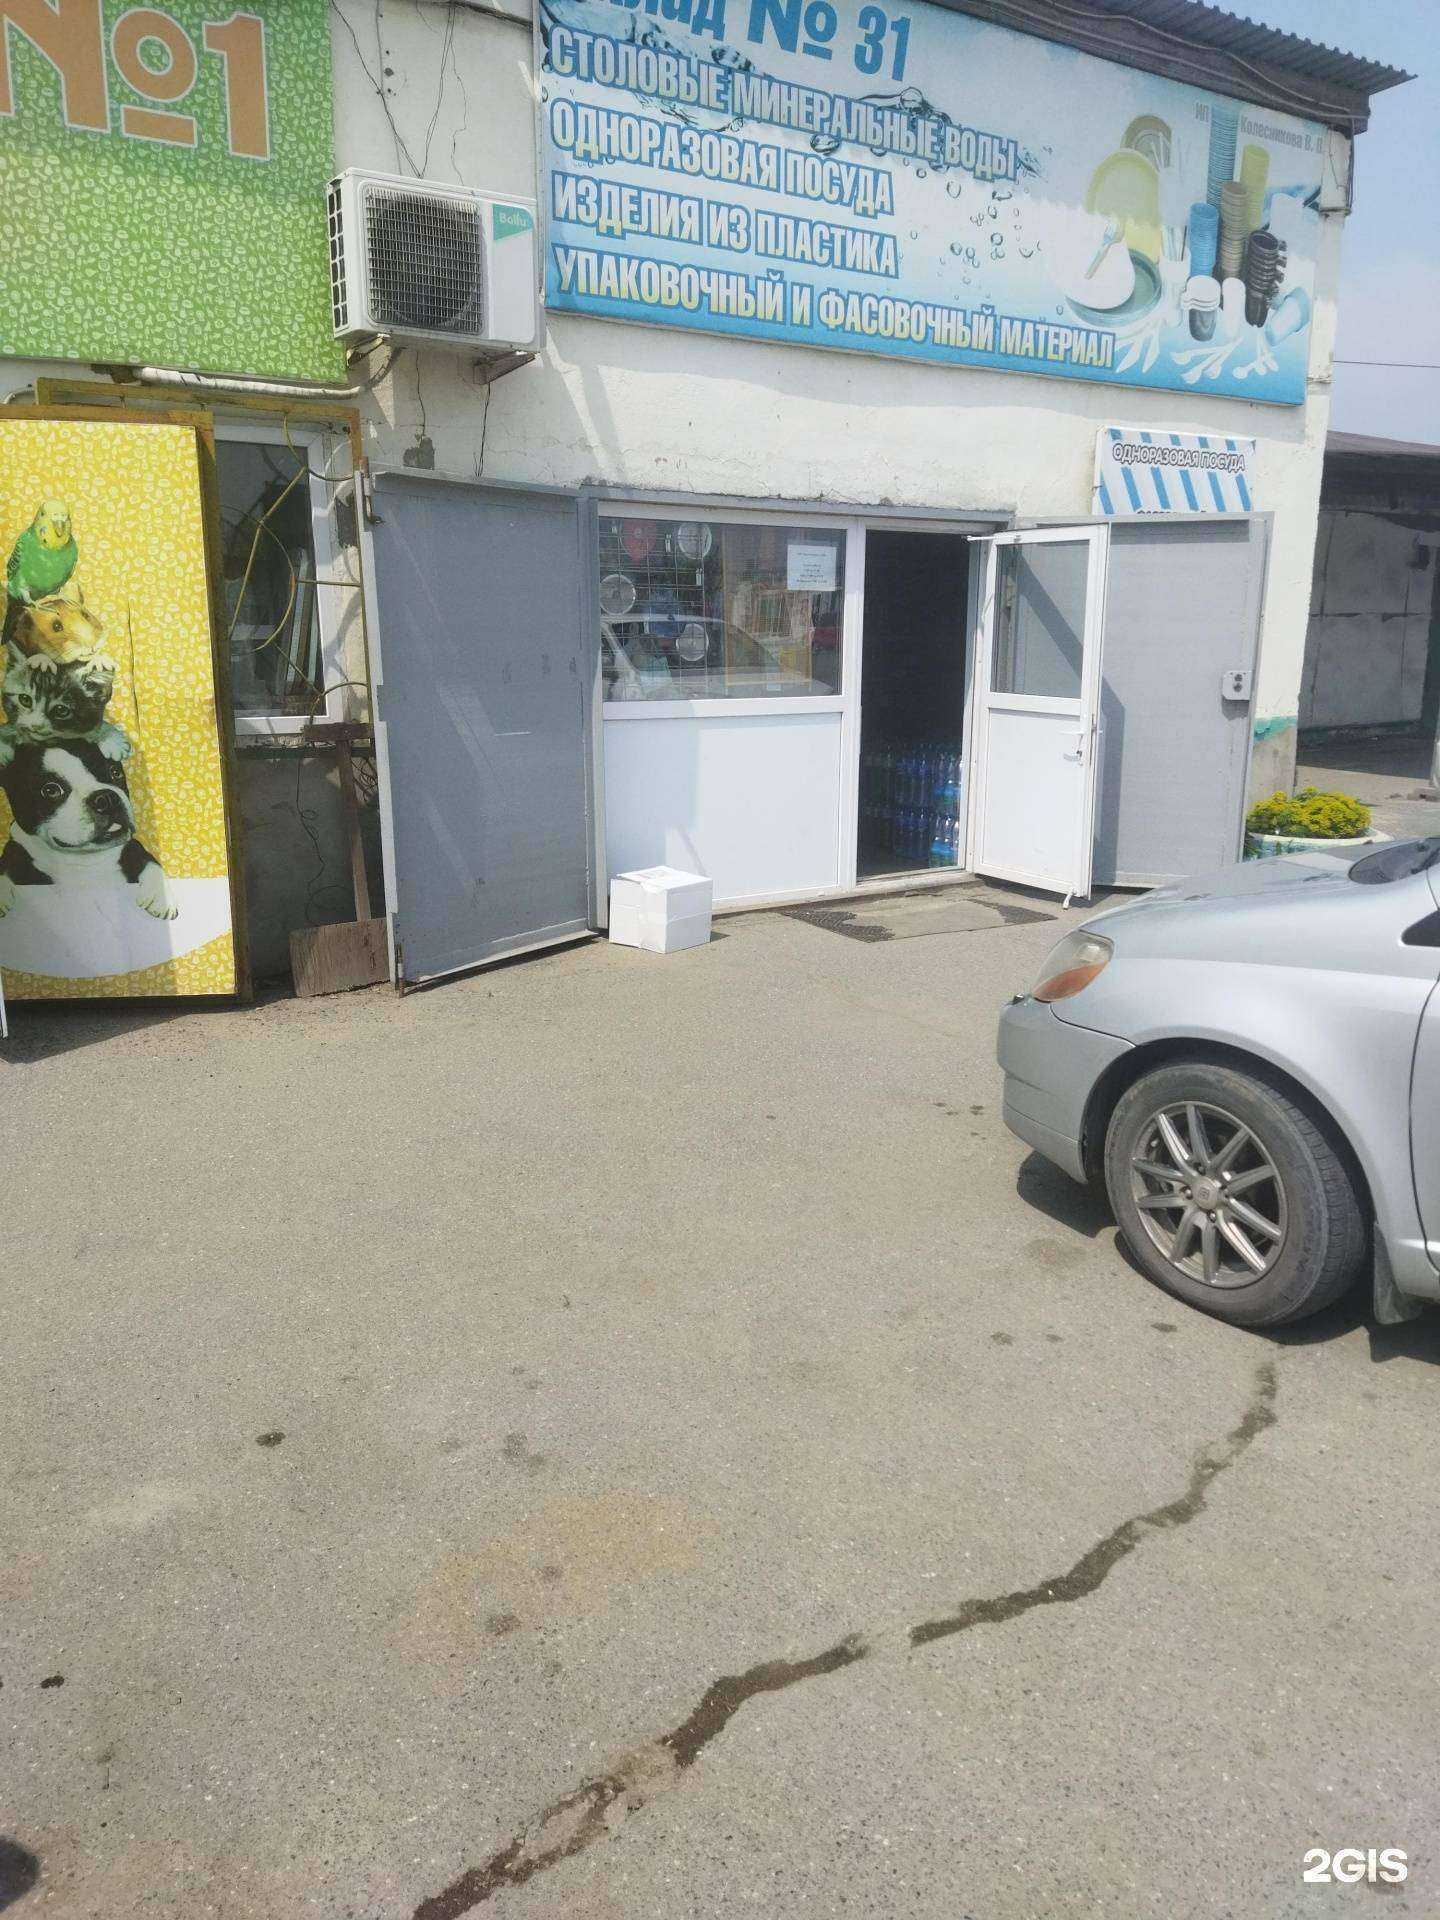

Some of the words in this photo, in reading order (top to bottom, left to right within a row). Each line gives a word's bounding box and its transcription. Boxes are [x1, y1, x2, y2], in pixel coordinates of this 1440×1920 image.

[854, 5, 911, 81] 31
[550, 25, 730, 113] СТОЛОВЫЕ
[730, 70, 940, 161] МИНЕРАЛЬНЫЕ
[943, 124, 1018, 182] ВОДЫ
[550, 98, 783, 192] ОДНОРАЗОВАЯ
[784, 147, 895, 219] ПОСУДА
[551, 170, 705, 246] ИЗДЕЛИЯ
[706, 198, 751, 252] ИЗ
[755, 209, 899, 279] ПЛАСТИКА
[551, 242, 788, 325] УПАКОВОЧНЫЙ
[790, 280, 815, 328] И
[819, 285, 997, 354] ФАСОВОЧНЫЙ
[999, 314, 1117, 370] МАТЕРИАЛ
[1112, 442, 1200, 468] ОДНОРАЗОВАЯ
[1200, 450, 1246, 474] ПОСУДА
